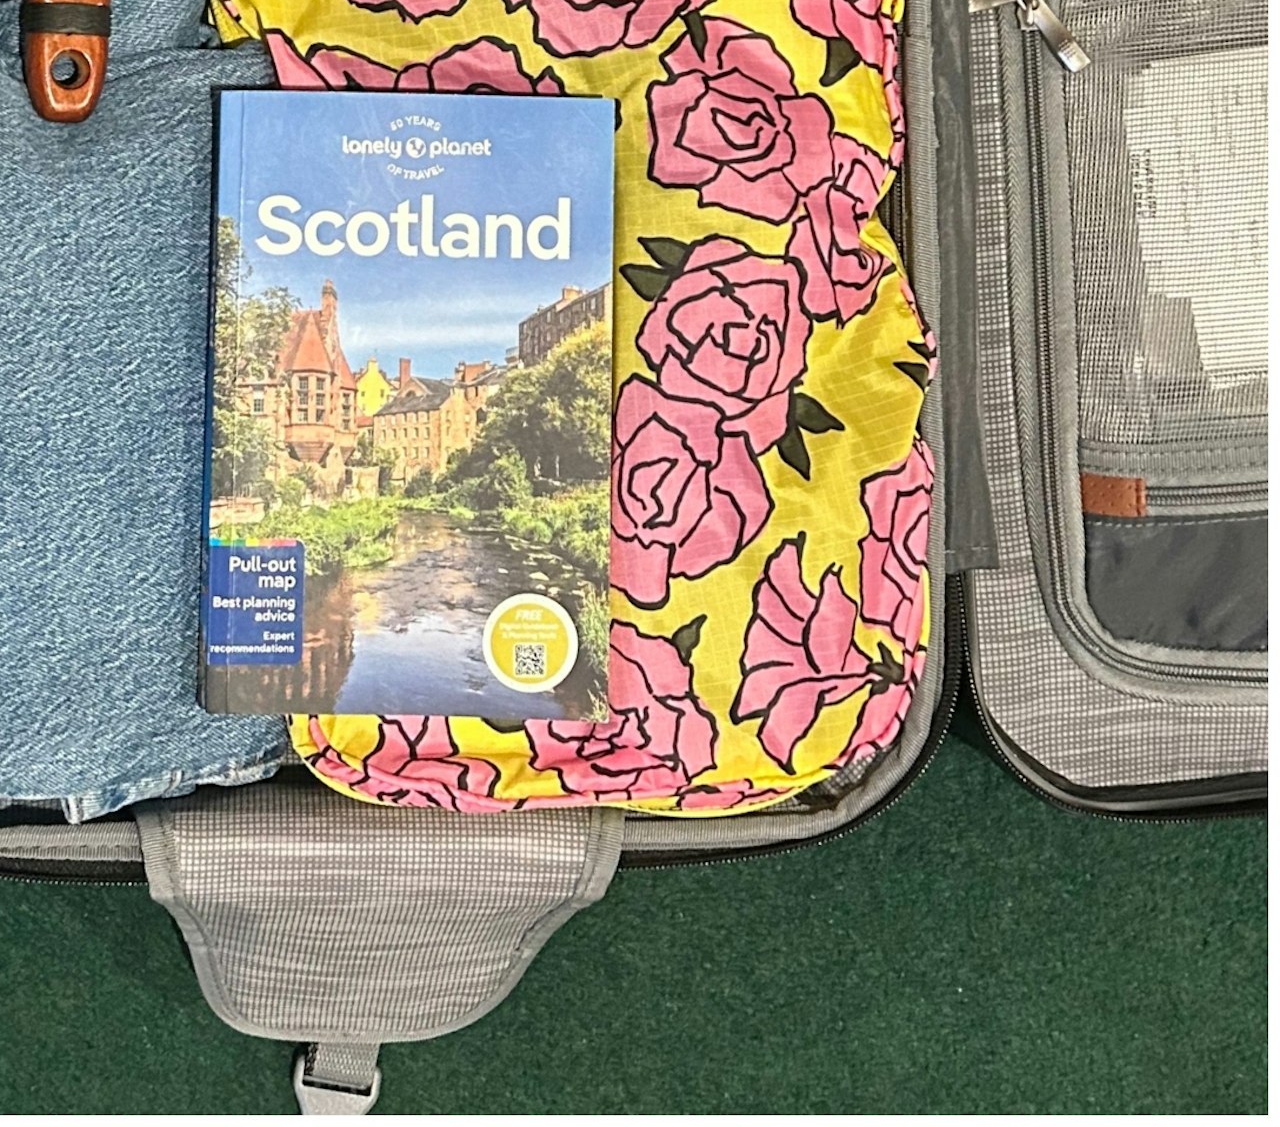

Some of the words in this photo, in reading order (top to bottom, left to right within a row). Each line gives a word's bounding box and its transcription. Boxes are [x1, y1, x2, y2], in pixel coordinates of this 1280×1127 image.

[405, 115, 442, 131] YEARS
[342, 135, 402, 160] lonely
[429, 137, 492, 159] planet
[386, 163, 402, 176] OF
[403, 164, 445, 181] TRAVEL
[255, 194, 572, 261] Scotland
[228, 555, 297, 573] Pull-out
[258, 575, 297, 592] map
[212, 596, 241, 608] Best
[242, 595, 296, 611] planning
[254, 609, 296, 622] advice
[263, 631, 295, 642] Expert
[209, 643, 295, 654] recommendations
